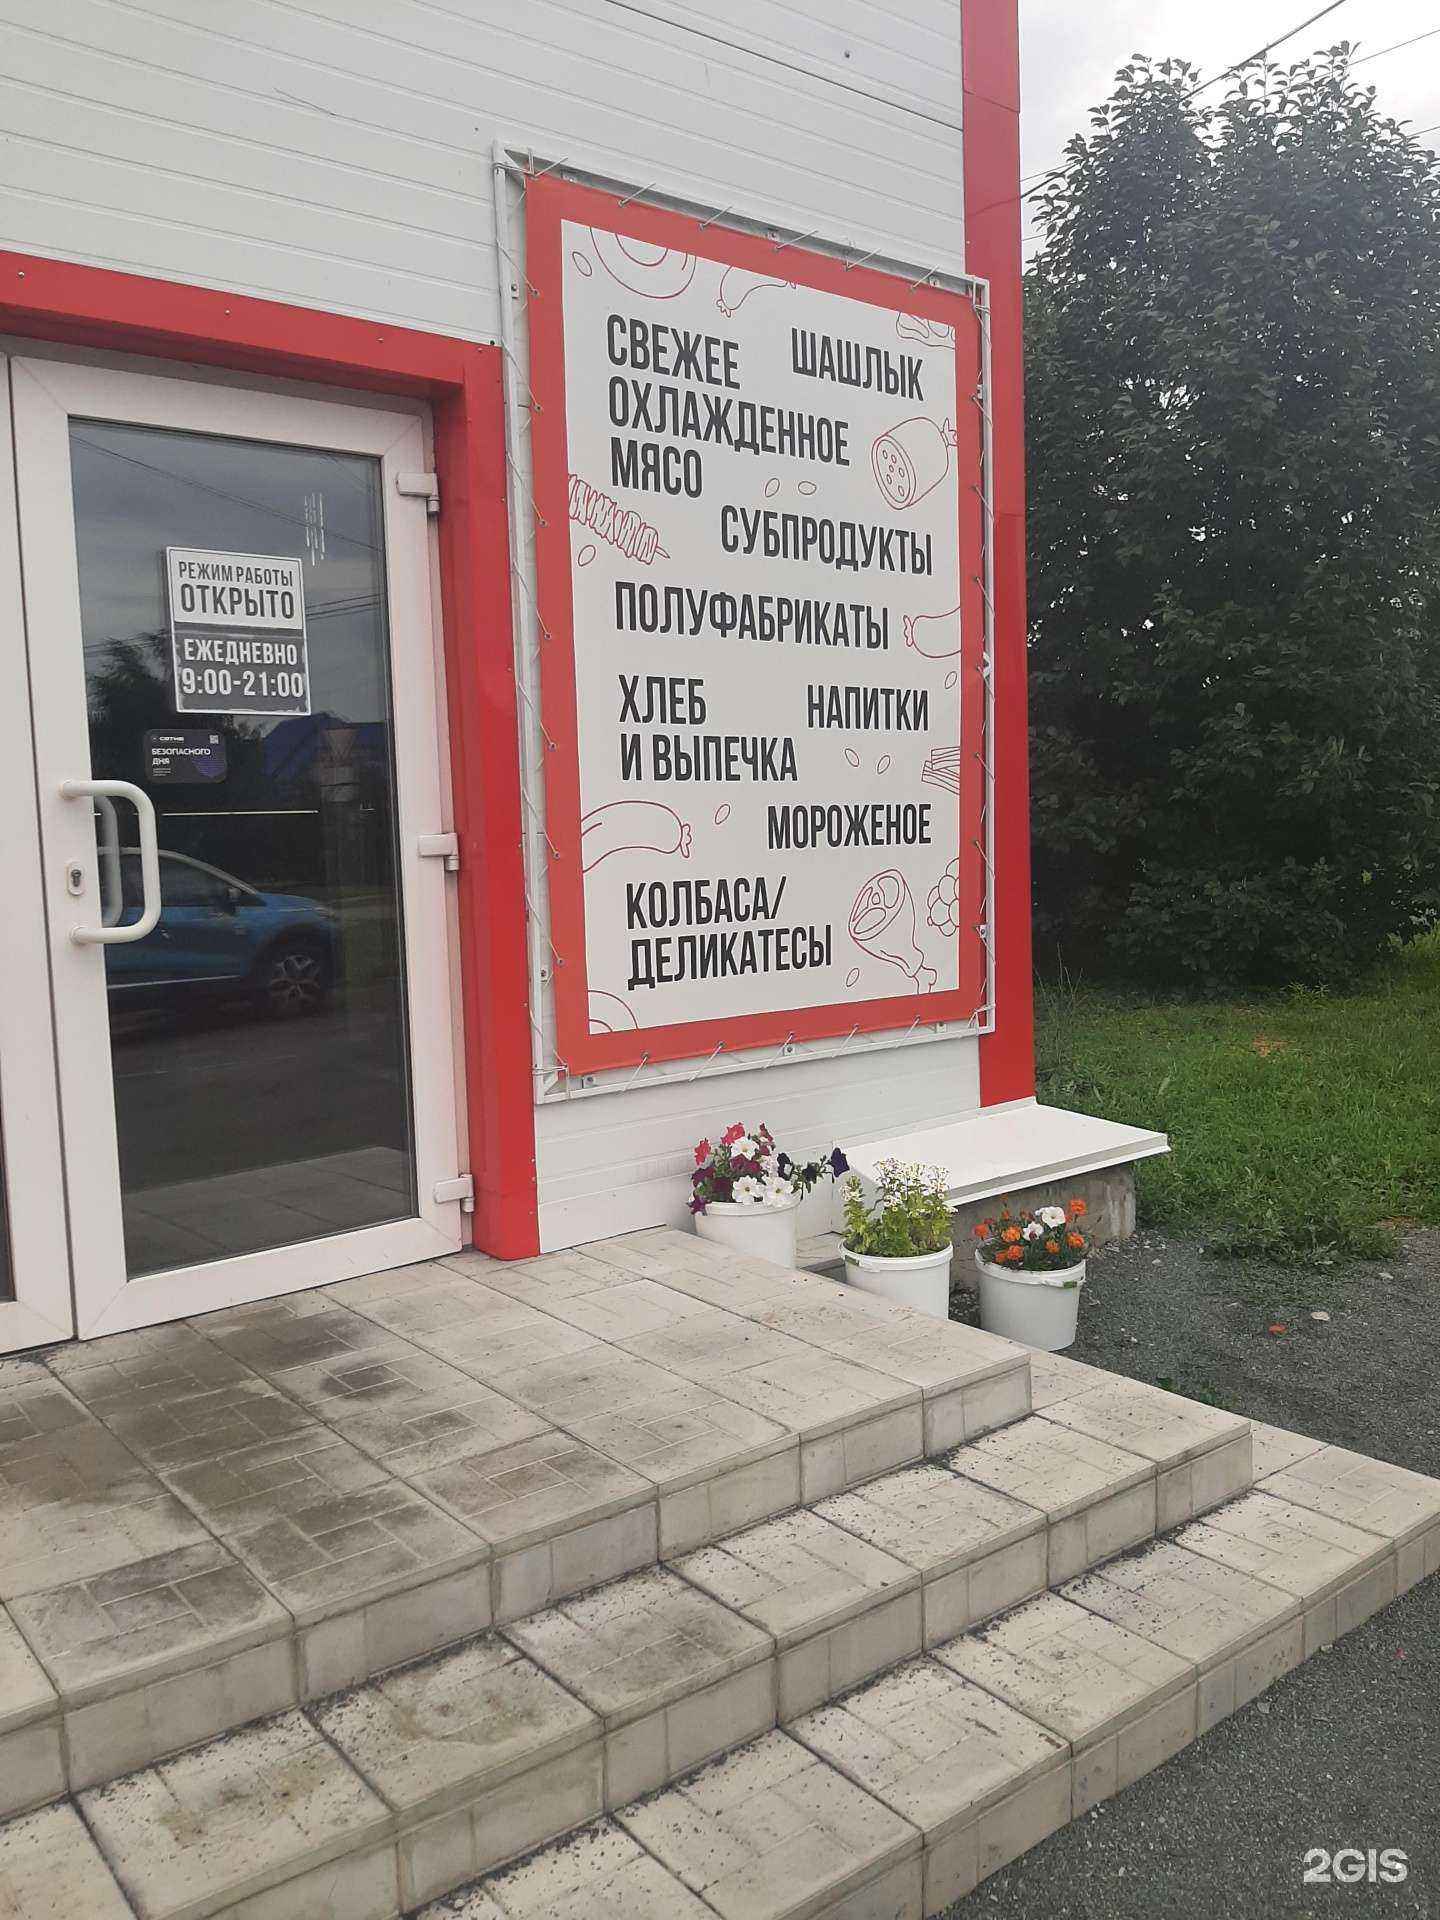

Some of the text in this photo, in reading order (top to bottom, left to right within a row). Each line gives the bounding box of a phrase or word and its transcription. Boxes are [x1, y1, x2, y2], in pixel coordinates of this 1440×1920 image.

[607, 314, 741, 390] СВЕЖЕЕ
[791, 327, 924, 402] ШАШЛЫК
[608, 375, 851, 467] ОХЛАЖДЕННОЕ
[610, 436, 703, 499] МЯСО
[721, 504, 933, 576] СУБПРОДУКТЫ
[178, 561, 293, 587] РЕЖИМ РАБОТЫ
[181, 583, 295, 619] ОТКРЫТО
[615, 581, 889, 650] ПОЛУФАБРИКАТЫ
[183, 638, 298, 666] ЕЖЕДНЕВНО
[181, 667, 304, 698] 9:00-21:00
[618, 674, 707, 725] ХЛЕБ
[807, 684, 929, 732] НАПИТКИ
[151, 748, 211, 756] БЕЗОПАСНОГО
[152, 757, 170, 766] ДНЯ
[620, 733, 799, 782] И ВЫПЕЧКА
[767, 803, 932, 850] МОРОЖЕНОЕ
[626, 876, 787, 930] КОЛБАСА/
[627, 925, 832, 991] ДЕЛИКАТЕСЫ
